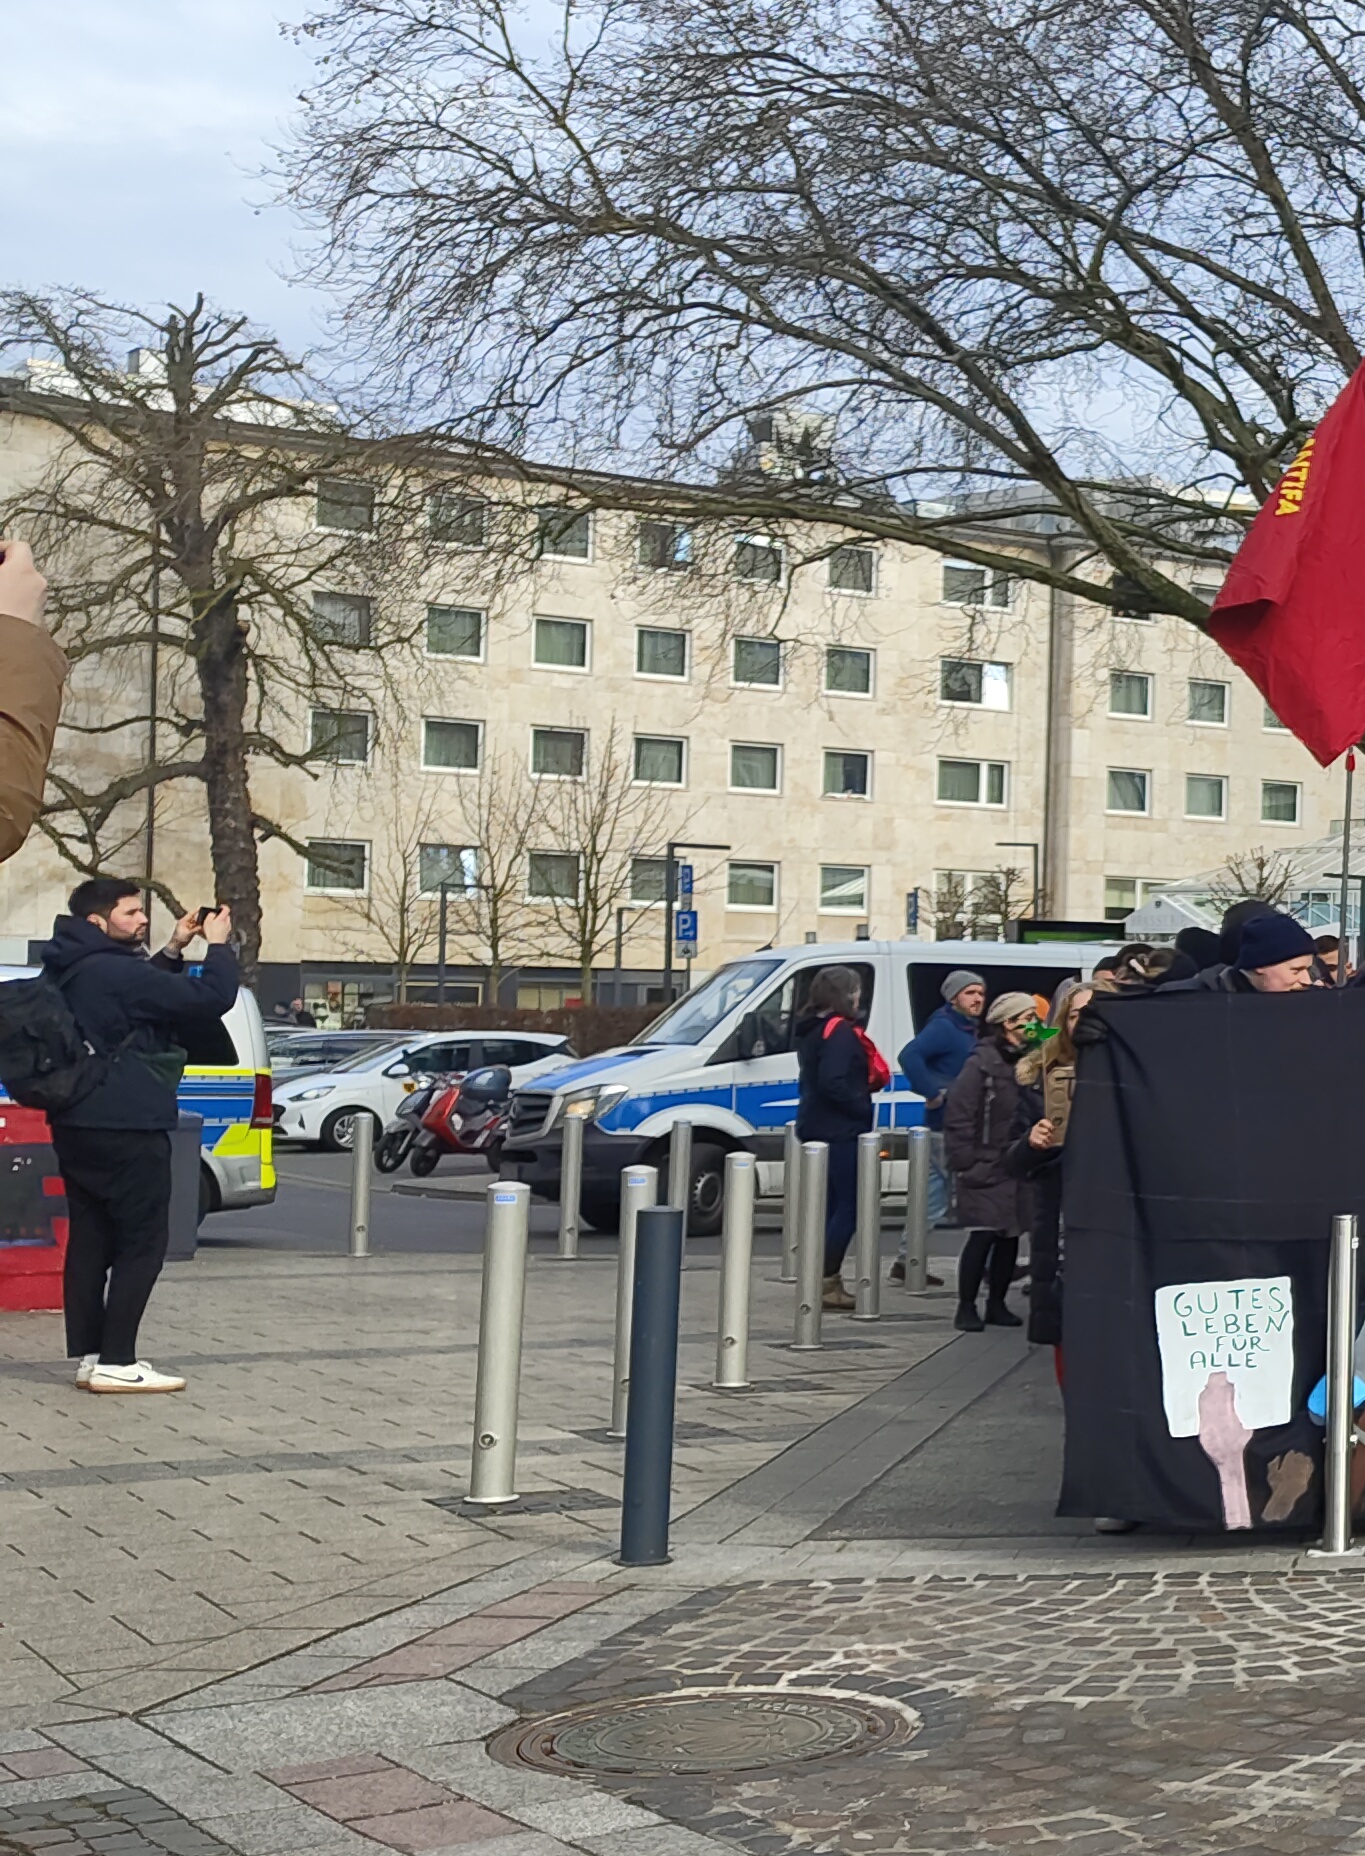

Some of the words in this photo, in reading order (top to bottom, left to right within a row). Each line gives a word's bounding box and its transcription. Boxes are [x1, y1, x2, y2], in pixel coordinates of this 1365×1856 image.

[679, 914, 692, 938] P
[1173, 1286, 1285, 1318] GUTES
[1181, 1310, 1290, 1337] LEBEN
[1215, 1333, 1270, 1352] FÜR
[1190, 1350, 1258, 1370] ALLE
